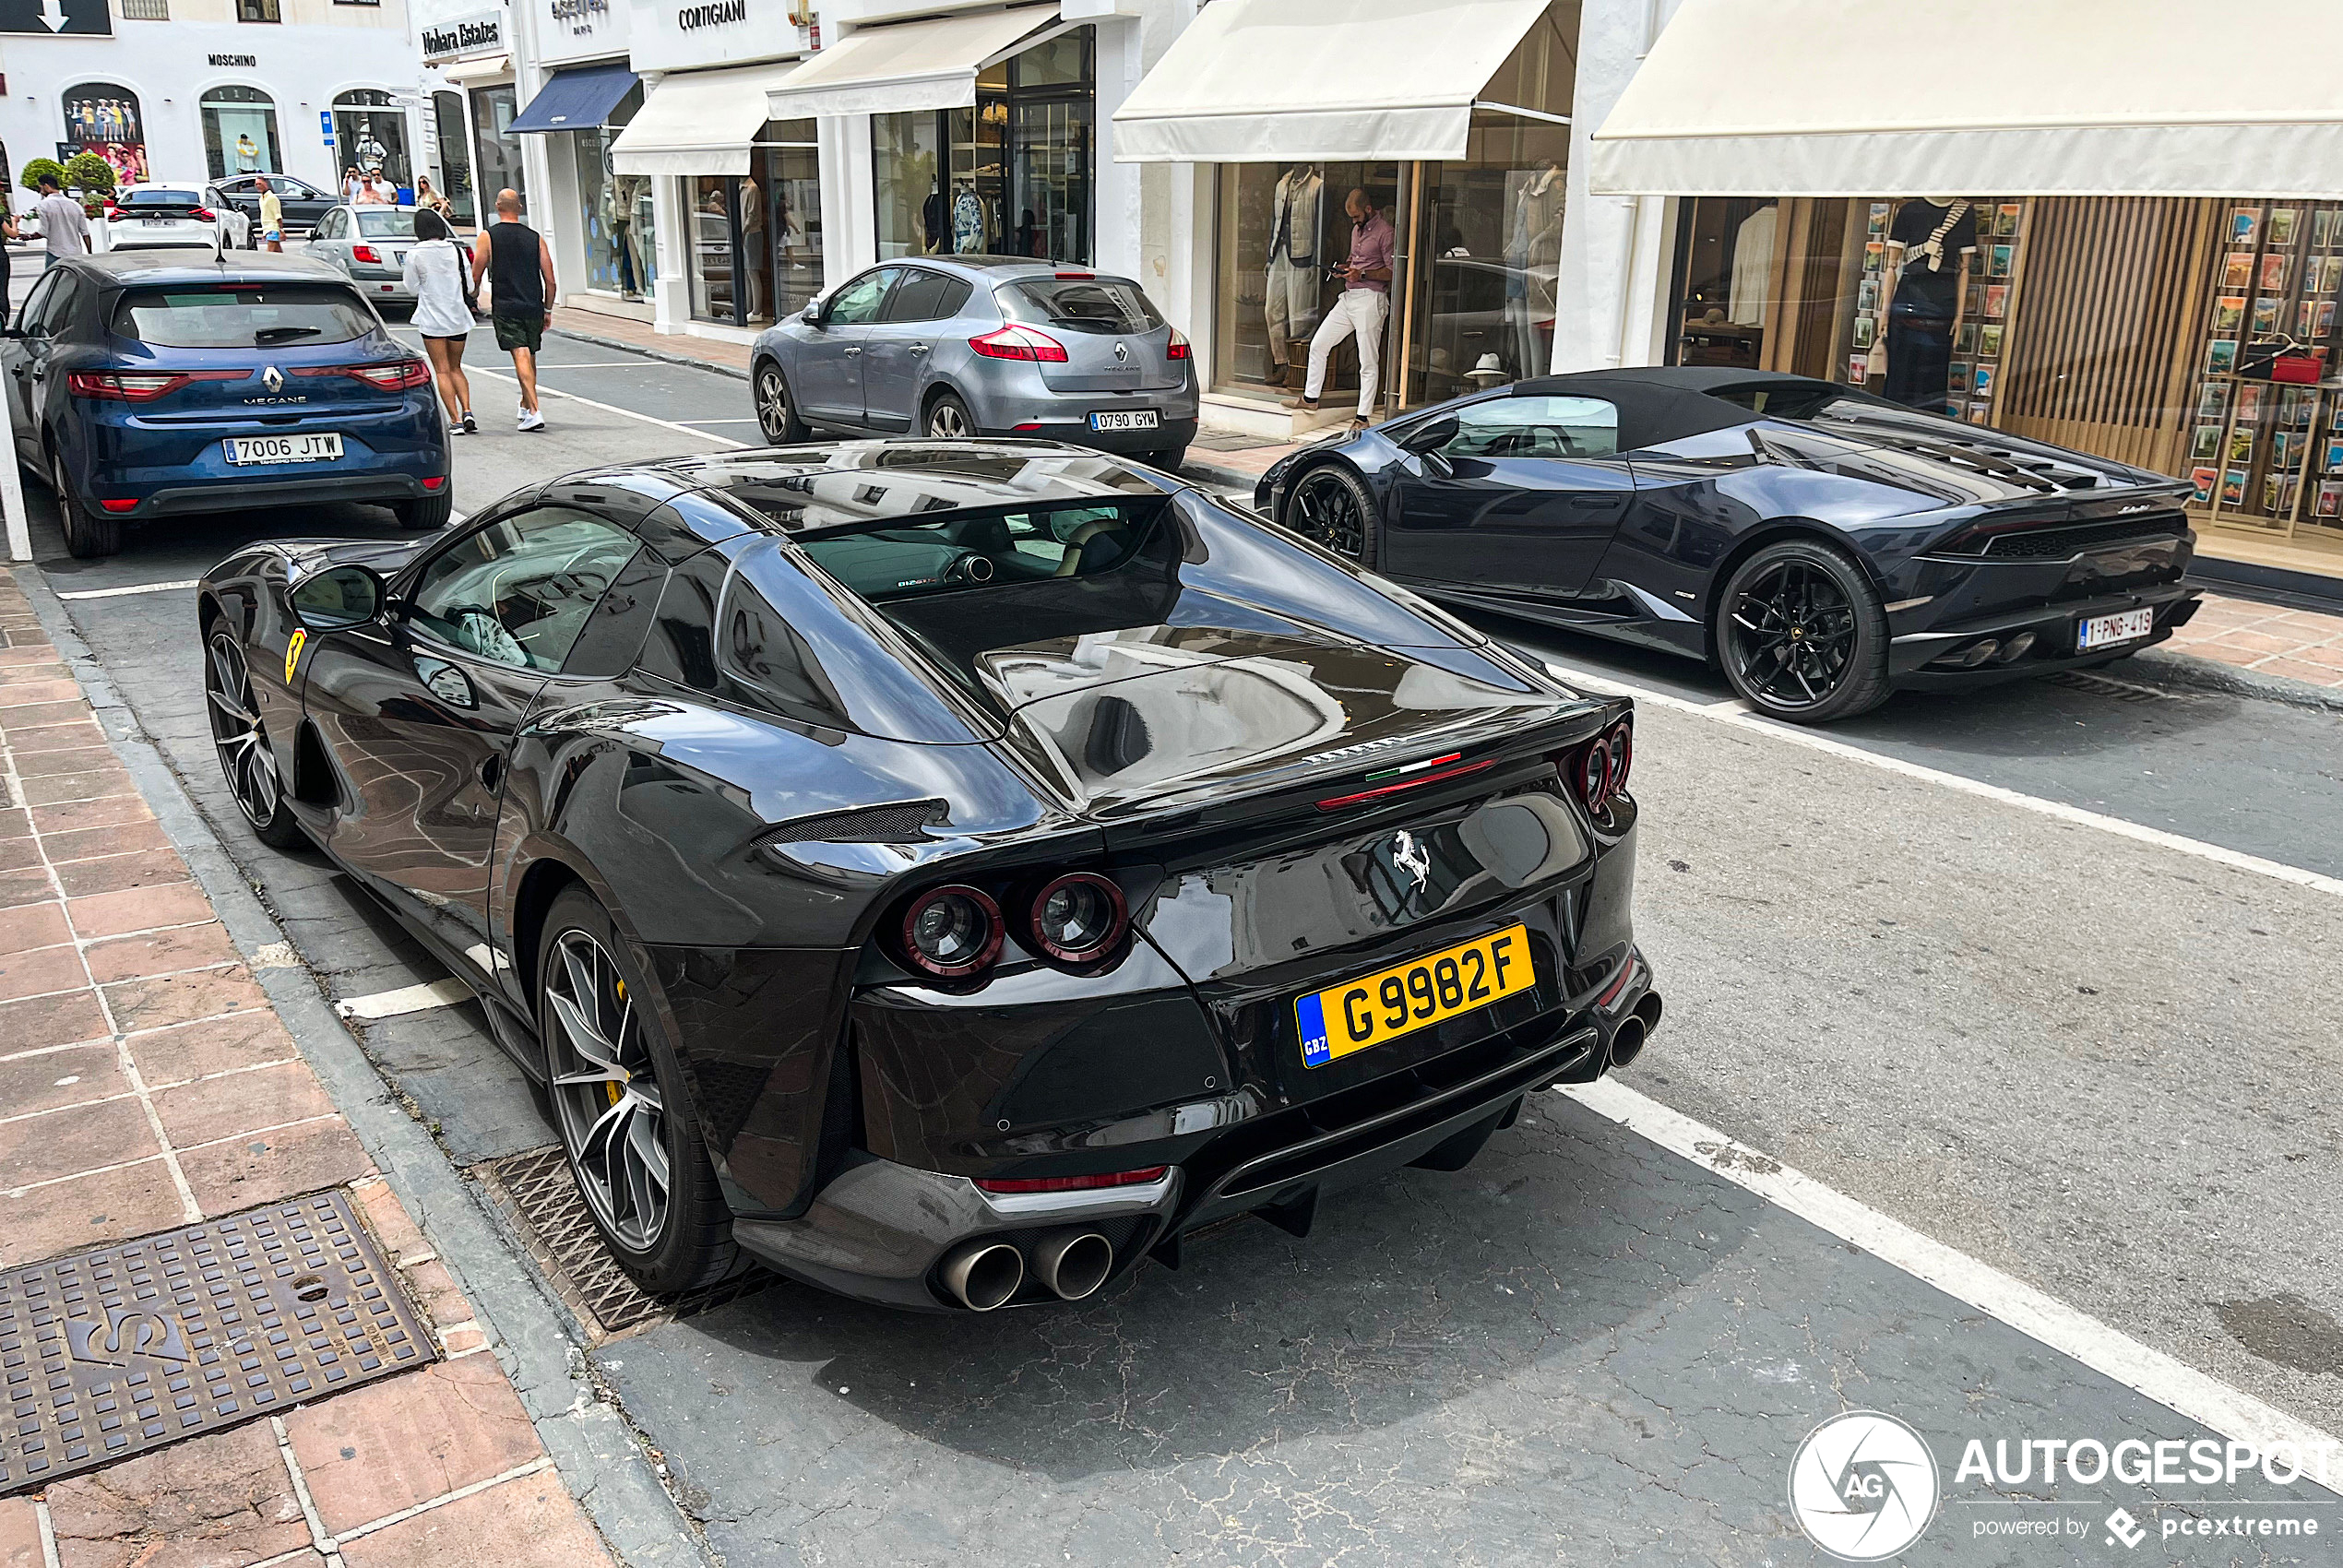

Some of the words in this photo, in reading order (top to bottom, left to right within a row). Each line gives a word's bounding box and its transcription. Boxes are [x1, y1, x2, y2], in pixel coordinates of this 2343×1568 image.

[679, 0, 745, 30] CORTIGIANI
[422, 28, 459, 54] Nohara
[458, 21, 498, 47] Estates
[208, 53, 256, 67] MOSCHINO
[1451, 385, 1481, 395] BRUNE
[244, 396, 307, 406] MEGANE
[1100, 413, 1130, 428] 0790
[1135, 412, 1156, 427] GYM
[238, 439, 291, 458] 7006
[300, 436, 336, 455] JTW
[1303, 1035, 1328, 1057] GBZ
